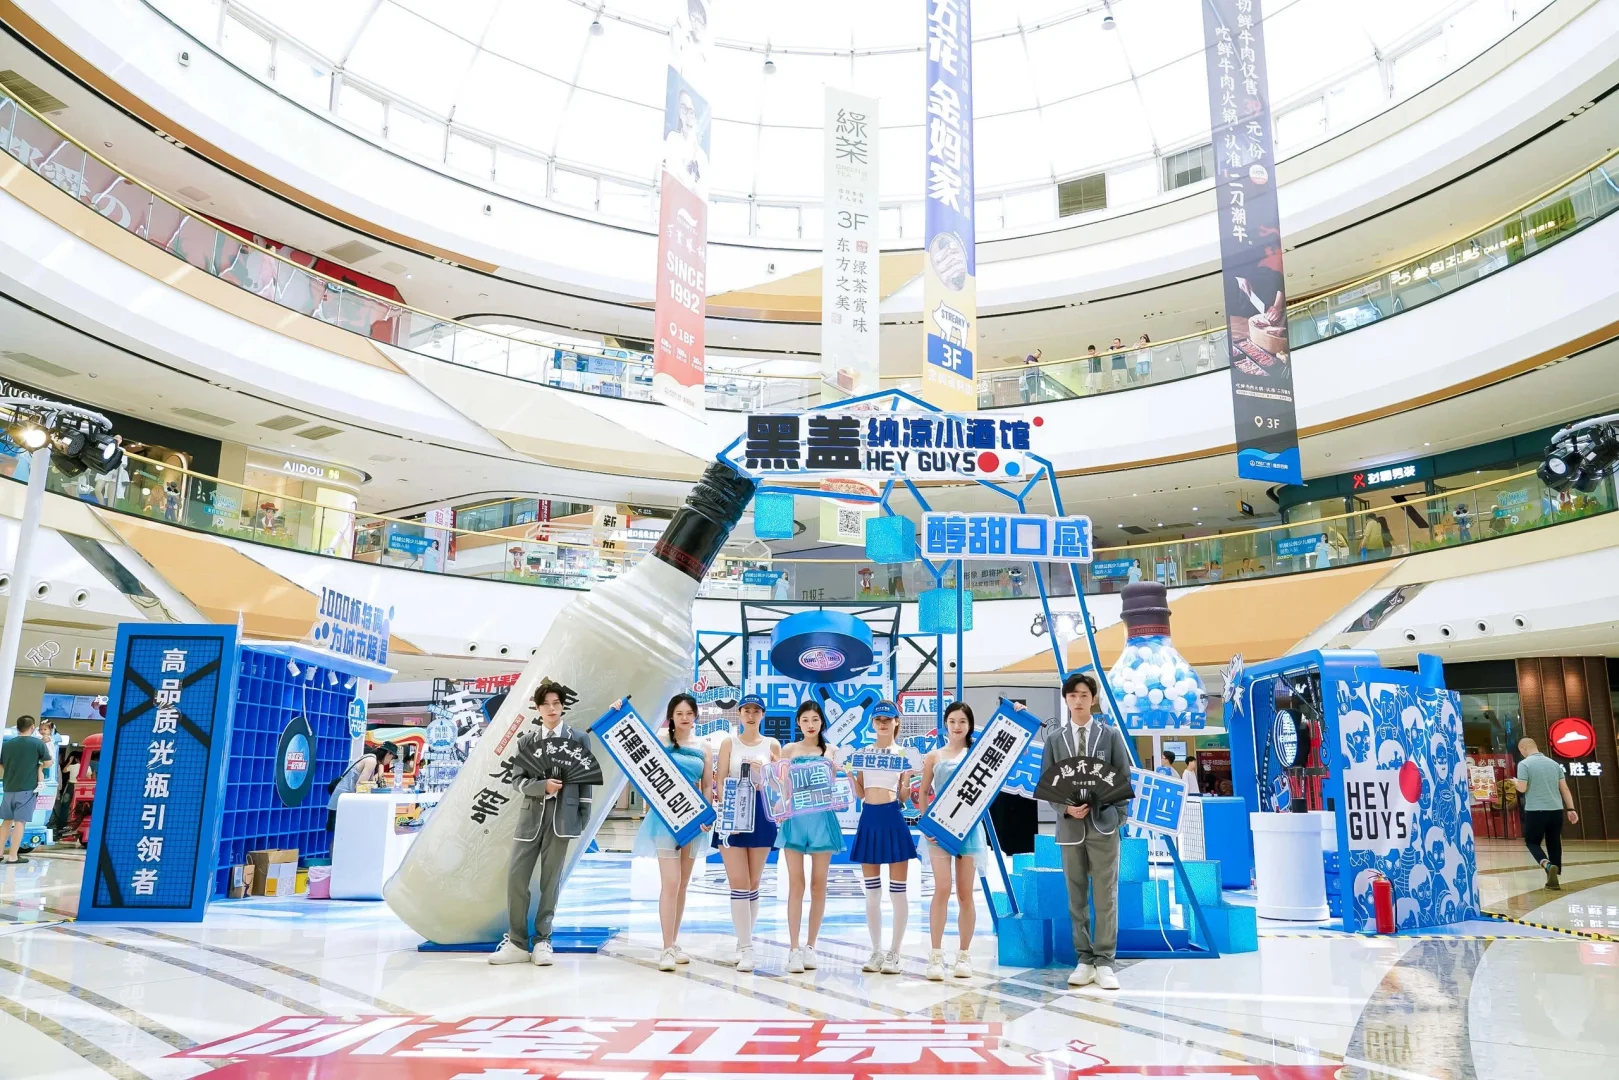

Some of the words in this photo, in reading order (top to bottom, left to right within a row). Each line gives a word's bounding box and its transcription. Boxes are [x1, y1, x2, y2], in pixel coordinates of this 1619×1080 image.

[927, 79, 961, 213] 金妈家
[837, 211, 868, 230] 3F
[666, 250, 704, 292] SINCE
[836, 237, 850, 311] 东方之美
[670, 278, 700, 315] 1992
[853, 260, 868, 333] 绿茶赏味
[941, 309, 965, 329] STREAKY
[678, 328, 695, 346] 1BF
[942, 343, 962, 371] 3F
[1266, 418, 1280, 429] 3F
[745, 415, 862, 469] 黑盖
[867, 417, 1030, 450] 纳凉小酒馆
[283, 460, 324, 477] AJIDOU
[866, 451, 908, 472] HEY
[918, 451, 976, 473] GUYS
[927, 515, 1092, 559] 醇甜口感
[131, 648, 188, 895] 高品质光瓶引领者
[852, 754, 901, 770] 盖世英雄
[948, 729, 1017, 819] 一起开黑盖
[1051, 759, 1115, 787] 一起开黑盖
[1559, 761, 1603, 777] 胜客
[666, 791, 695, 819] GUY
[792, 782, 852, 810] 更正宗
[1346, 781, 1390, 810] HEY
[1349, 811, 1407, 841] GUYS
